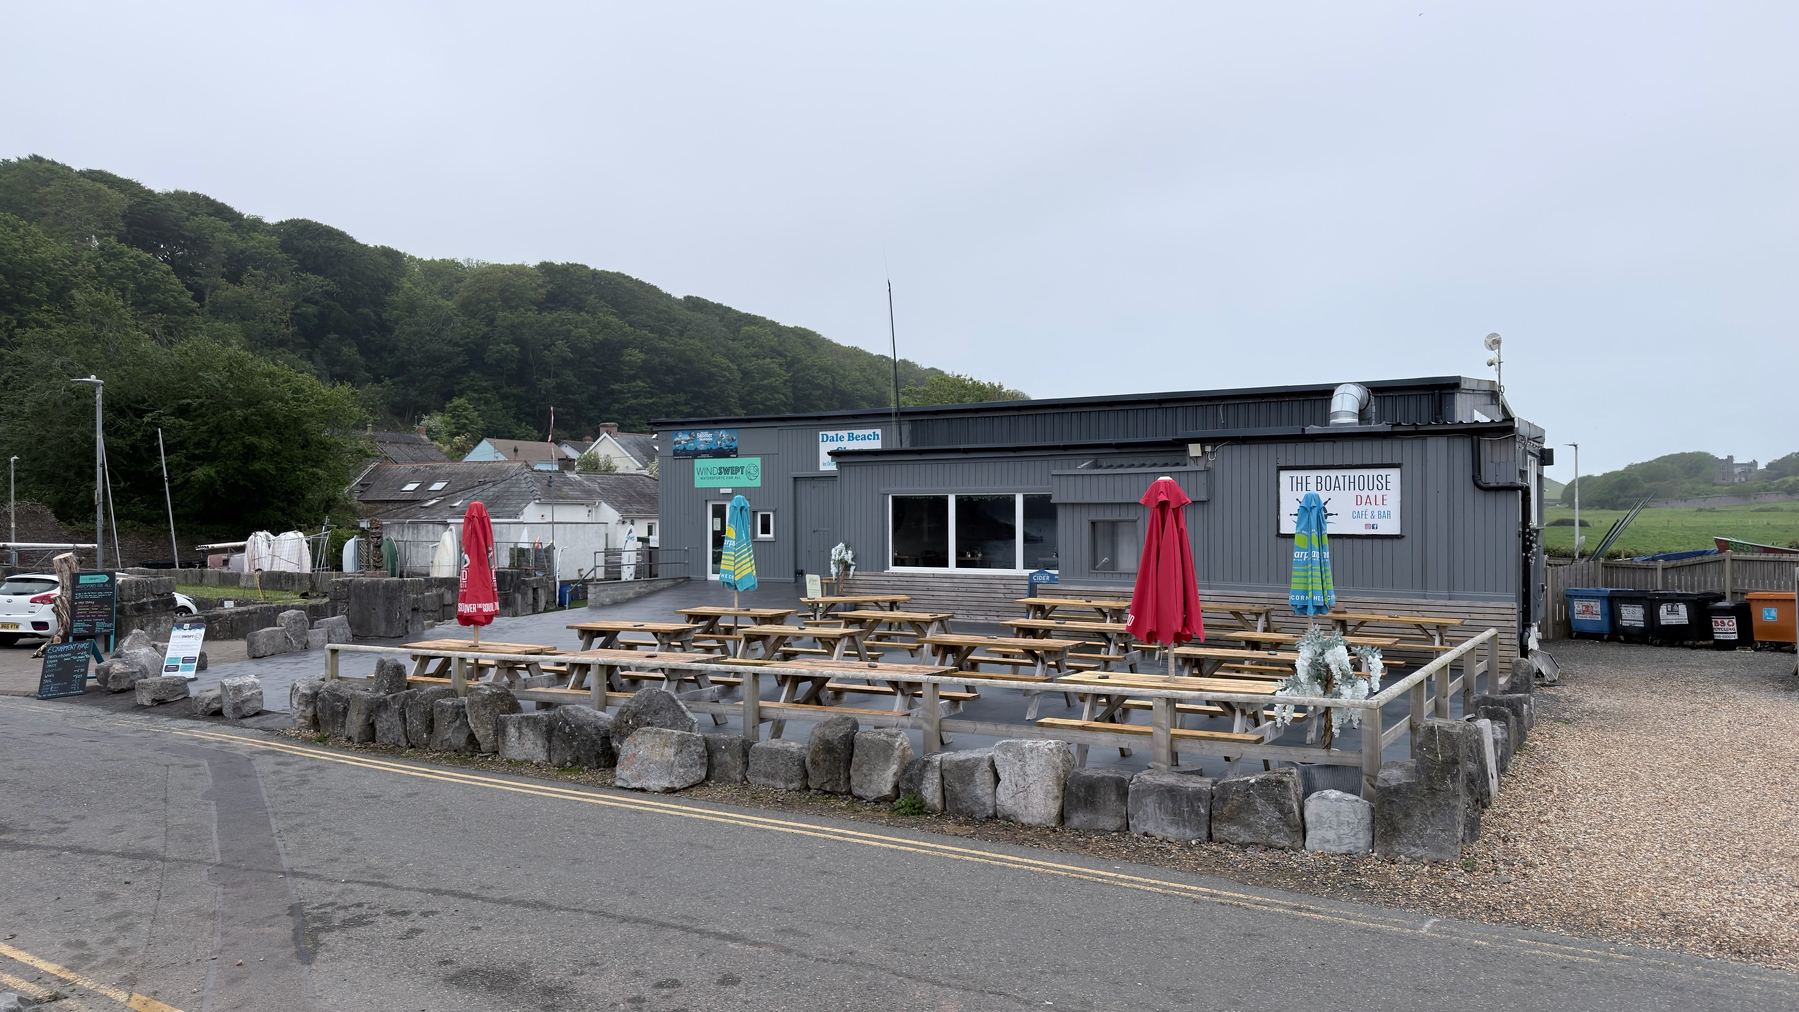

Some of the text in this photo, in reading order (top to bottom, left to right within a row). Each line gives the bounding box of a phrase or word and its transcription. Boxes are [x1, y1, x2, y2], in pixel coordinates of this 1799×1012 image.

[820, 431, 880, 442] Dale Beach
[696, 466, 745, 476] WINDSWEPT
[1290, 474, 1392, 492] THE BOATHOUSE
[1356, 494, 1387, 506] DALE
[1352, 509, 1392, 520] CAFÉ & BAR
[1728, 542, 1752, 553] RED
